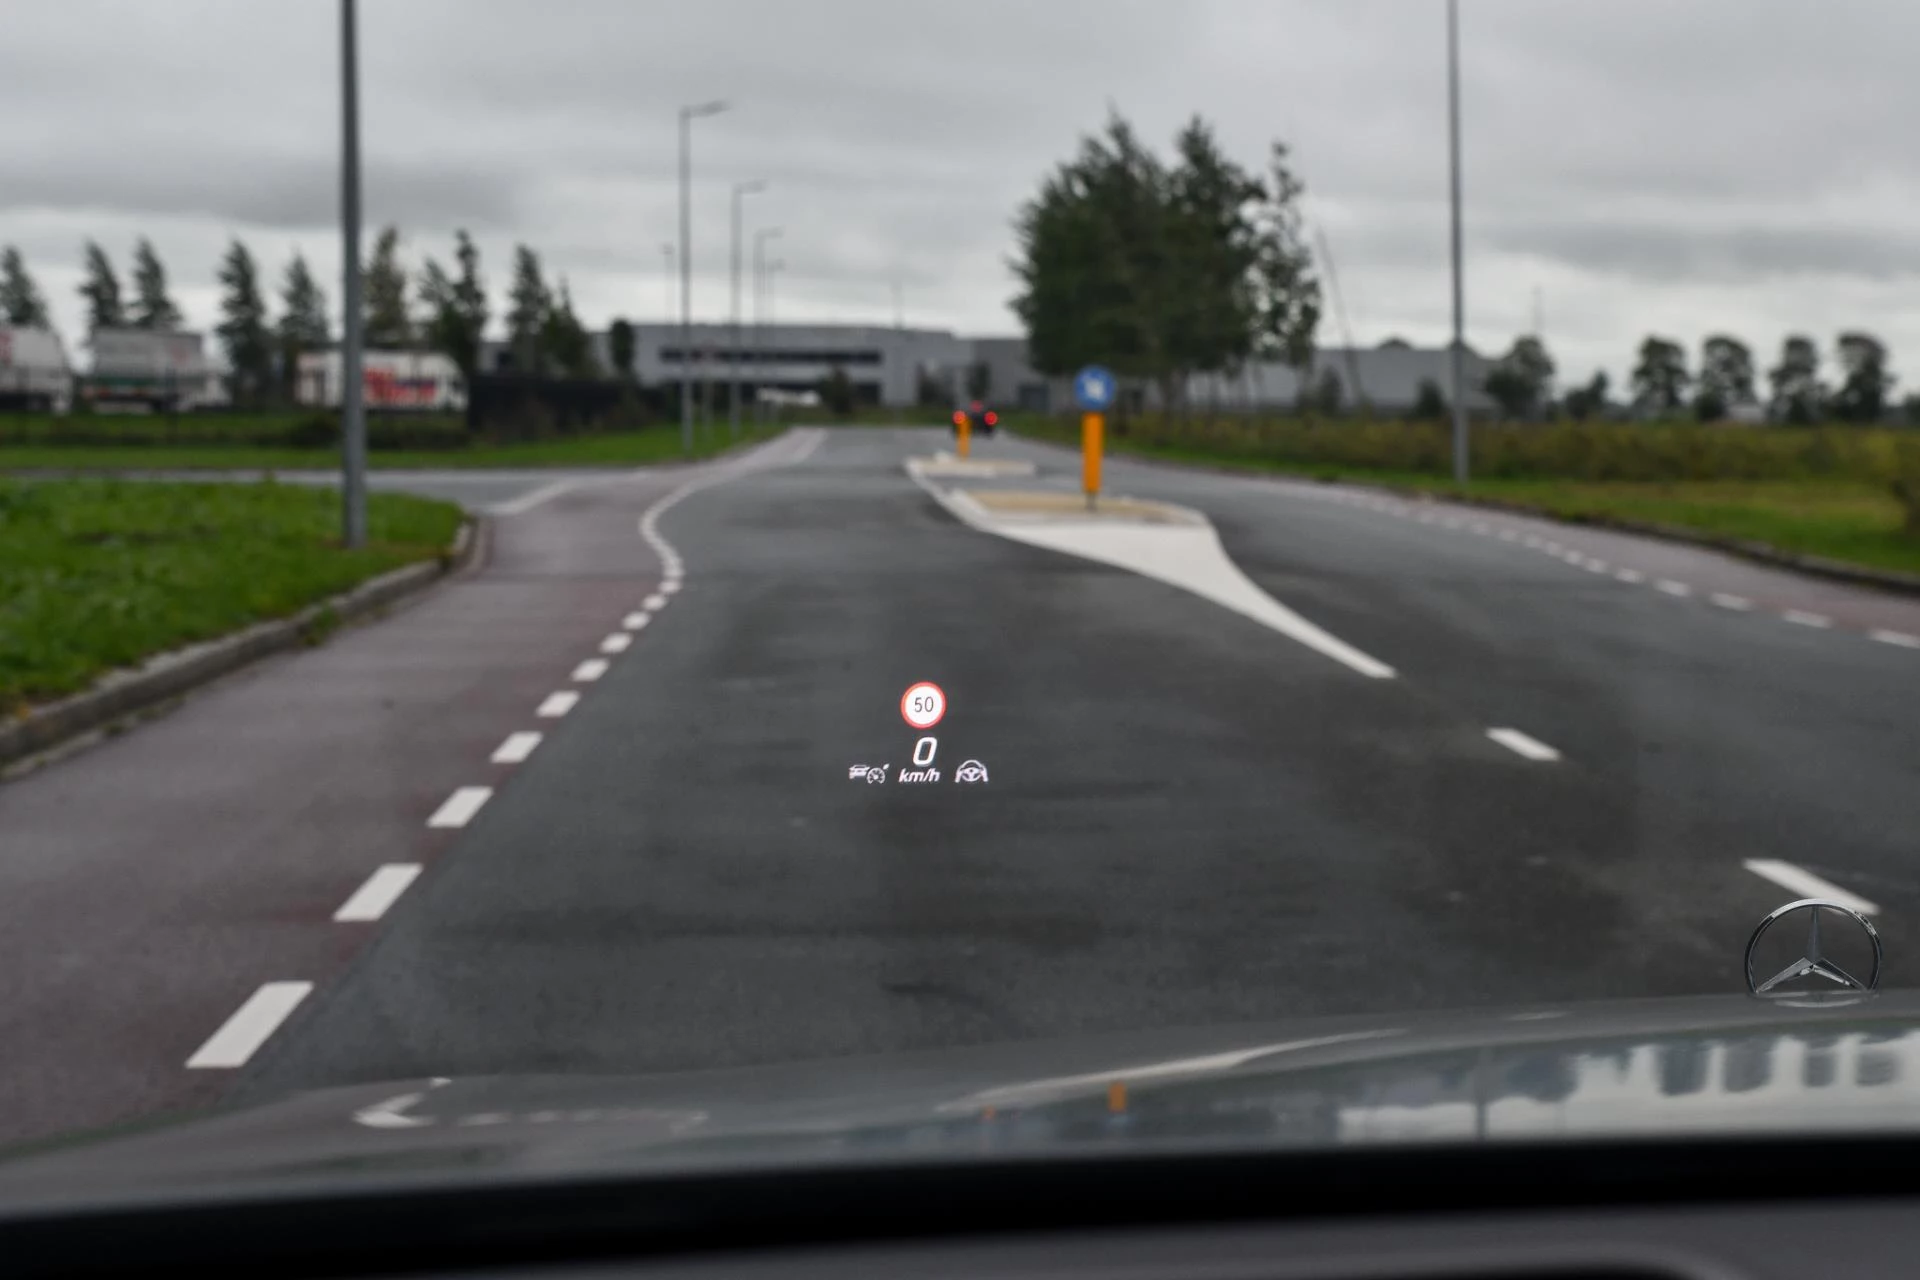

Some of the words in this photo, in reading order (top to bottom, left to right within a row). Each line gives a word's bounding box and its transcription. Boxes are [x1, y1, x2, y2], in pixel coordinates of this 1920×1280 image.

[914, 696, 934, 713] 50
[912, 736, 938, 766] 0
[898, 767, 941, 783] km/h
